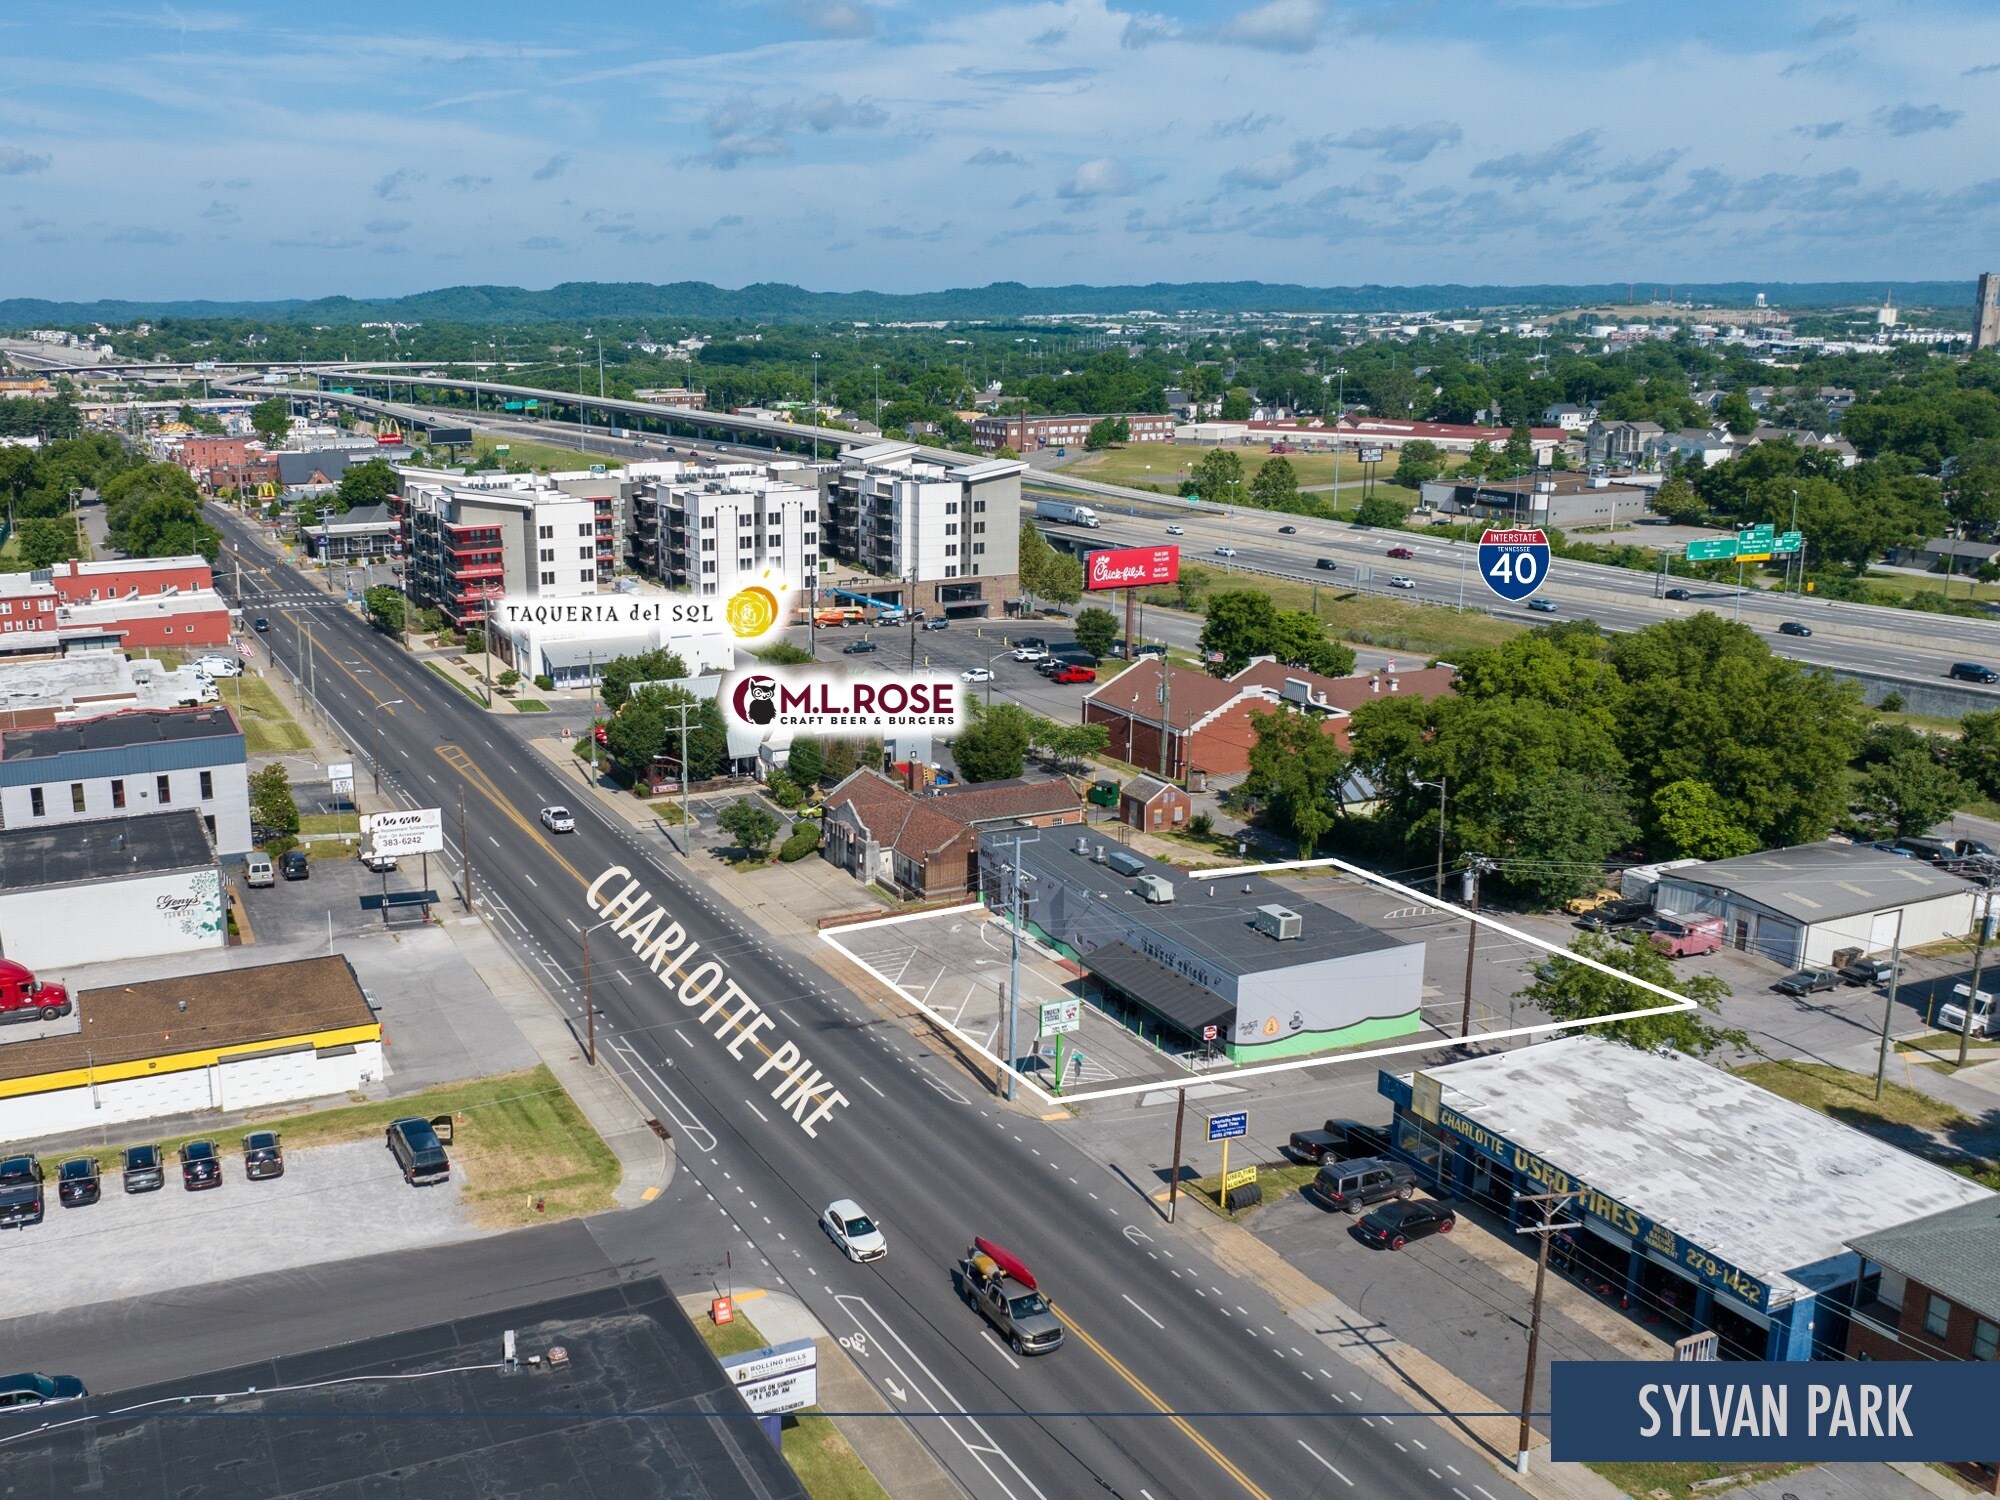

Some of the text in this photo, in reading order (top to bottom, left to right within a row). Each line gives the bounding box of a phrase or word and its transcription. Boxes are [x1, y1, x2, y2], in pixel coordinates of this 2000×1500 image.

[382, 836, 422, 847] 383-6242
[1440, 1112, 1503, 1156] CHARLOTTE
[1515, 1147, 1640, 1236] USED TIRES
[1686, 1247, 1760, 1305] 279-1422
[750, 1353, 806, 1372] ROLLING HILLS
[777, 1378, 797, 1388] SUNDAY
